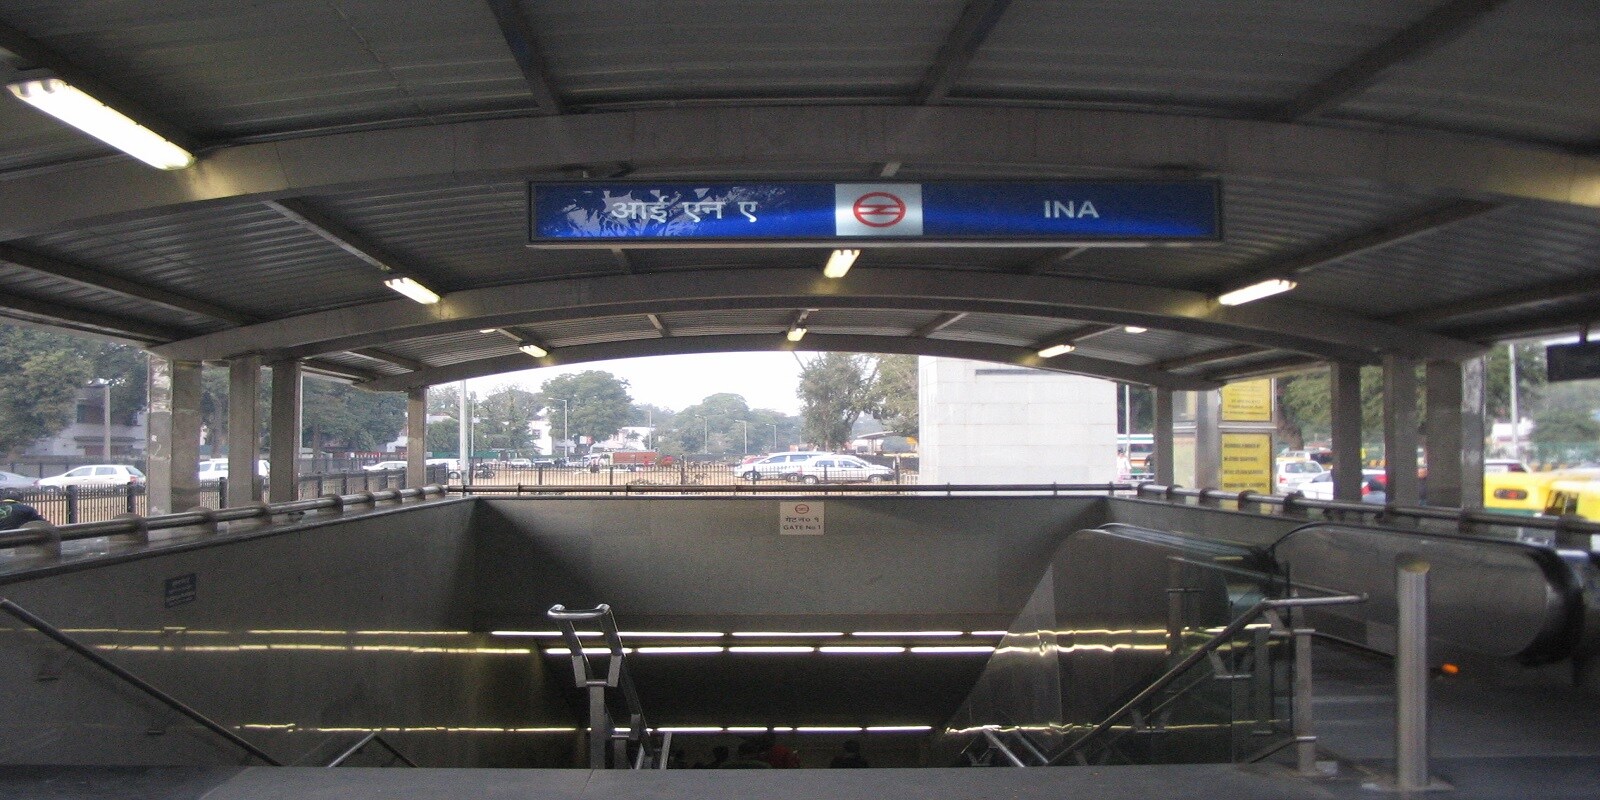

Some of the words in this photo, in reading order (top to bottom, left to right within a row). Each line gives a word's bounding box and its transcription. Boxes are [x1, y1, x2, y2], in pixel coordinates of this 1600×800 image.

[611, 195, 670, 223] आई
[682, 201, 726, 222] एन
[737, 201, 758, 222] ए
[1044, 200, 1100, 218] INA
